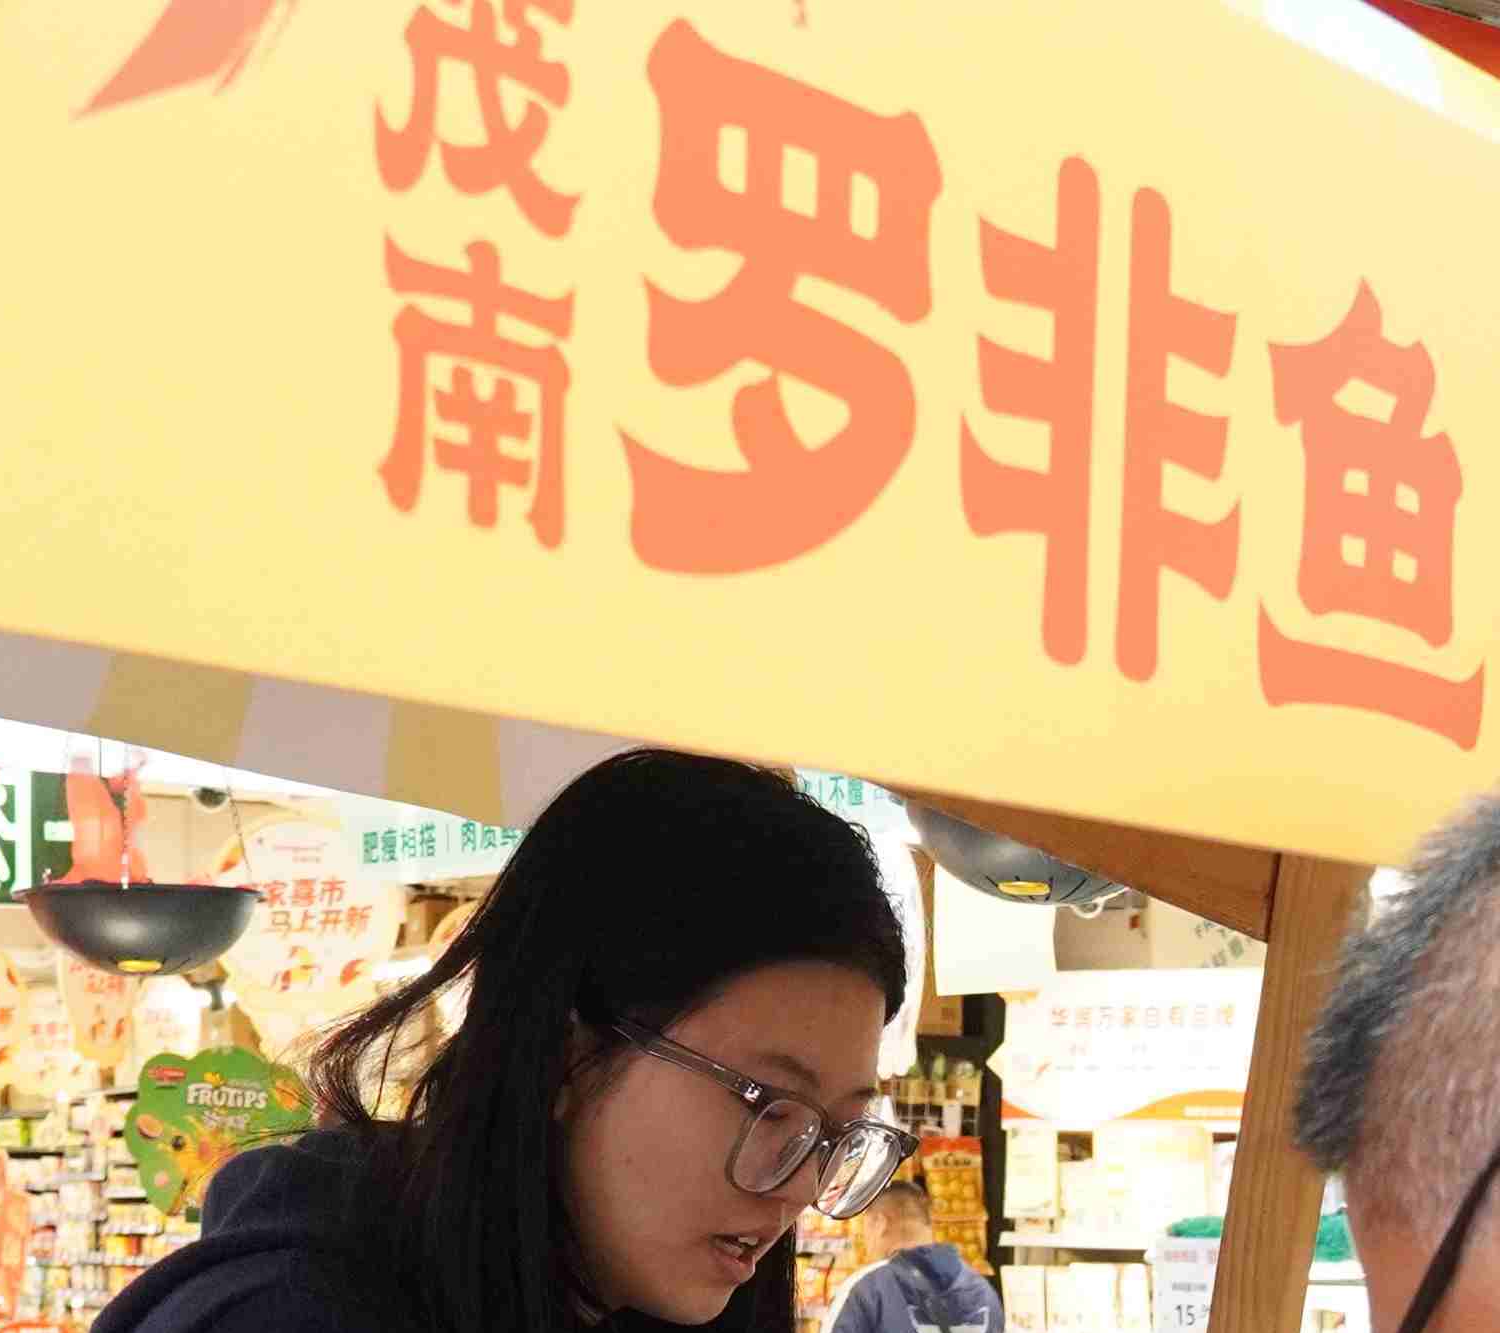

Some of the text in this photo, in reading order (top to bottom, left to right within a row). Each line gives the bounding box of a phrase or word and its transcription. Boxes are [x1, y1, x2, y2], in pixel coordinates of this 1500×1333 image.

[617, 17, 1487, 752] 罗非鱼
[252, 877, 347, 908] 家喜市
